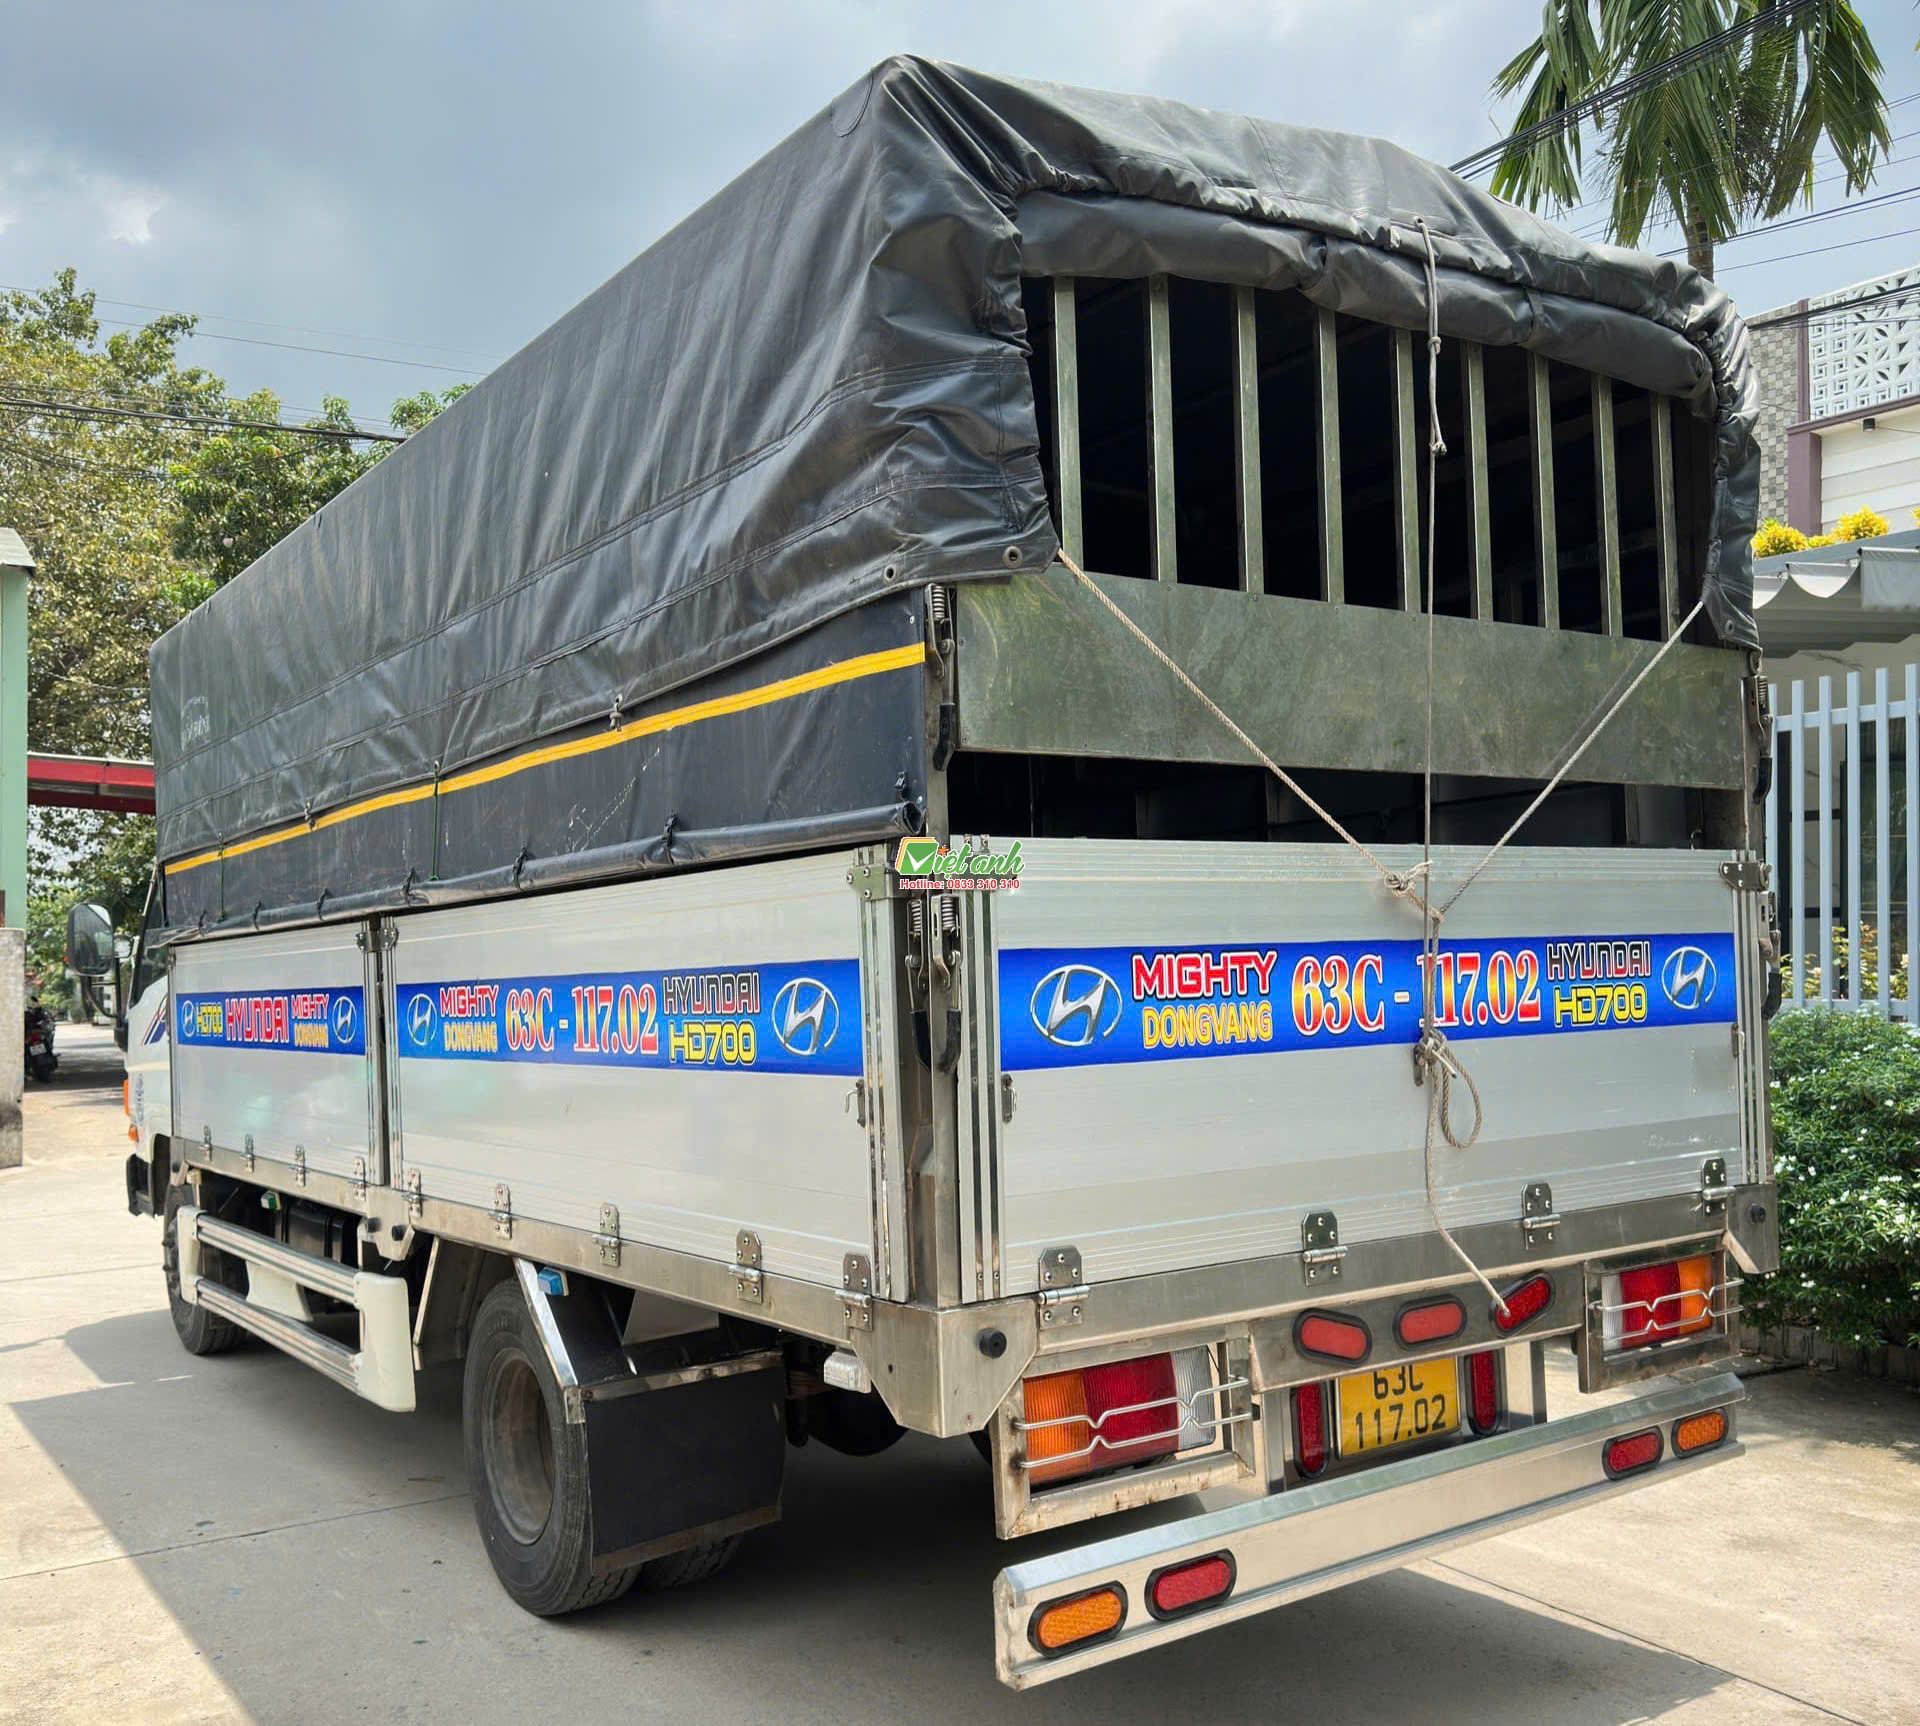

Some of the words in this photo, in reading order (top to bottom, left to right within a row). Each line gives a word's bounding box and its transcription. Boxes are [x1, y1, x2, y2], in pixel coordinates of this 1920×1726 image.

[1131, 950, 1278, 1001] MIGHTY
[1546, 940, 1652, 981] HYUNDAI
[291, 993, 330, 1020] MIGHTY
[440, 984, 499, 1018] MIGHTY
[662, 972, 761, 1015] HYUNDAI
[1291, 954, 1385, 1036] 63C
[1554, 982, 1649, 1028] HD700
[225, 996, 290, 1043] HYUNDAI
[444, 1021, 497, 1053] DONGVANG
[505, 987, 554, 1052] 63C
[572, 983, 659, 1054] 117.02
[1143, 1000, 1273, 1049] DONGVANG
[669, 1019, 759, 1066] HD700
[1355, 1394, 1446, 1449] 117.02
